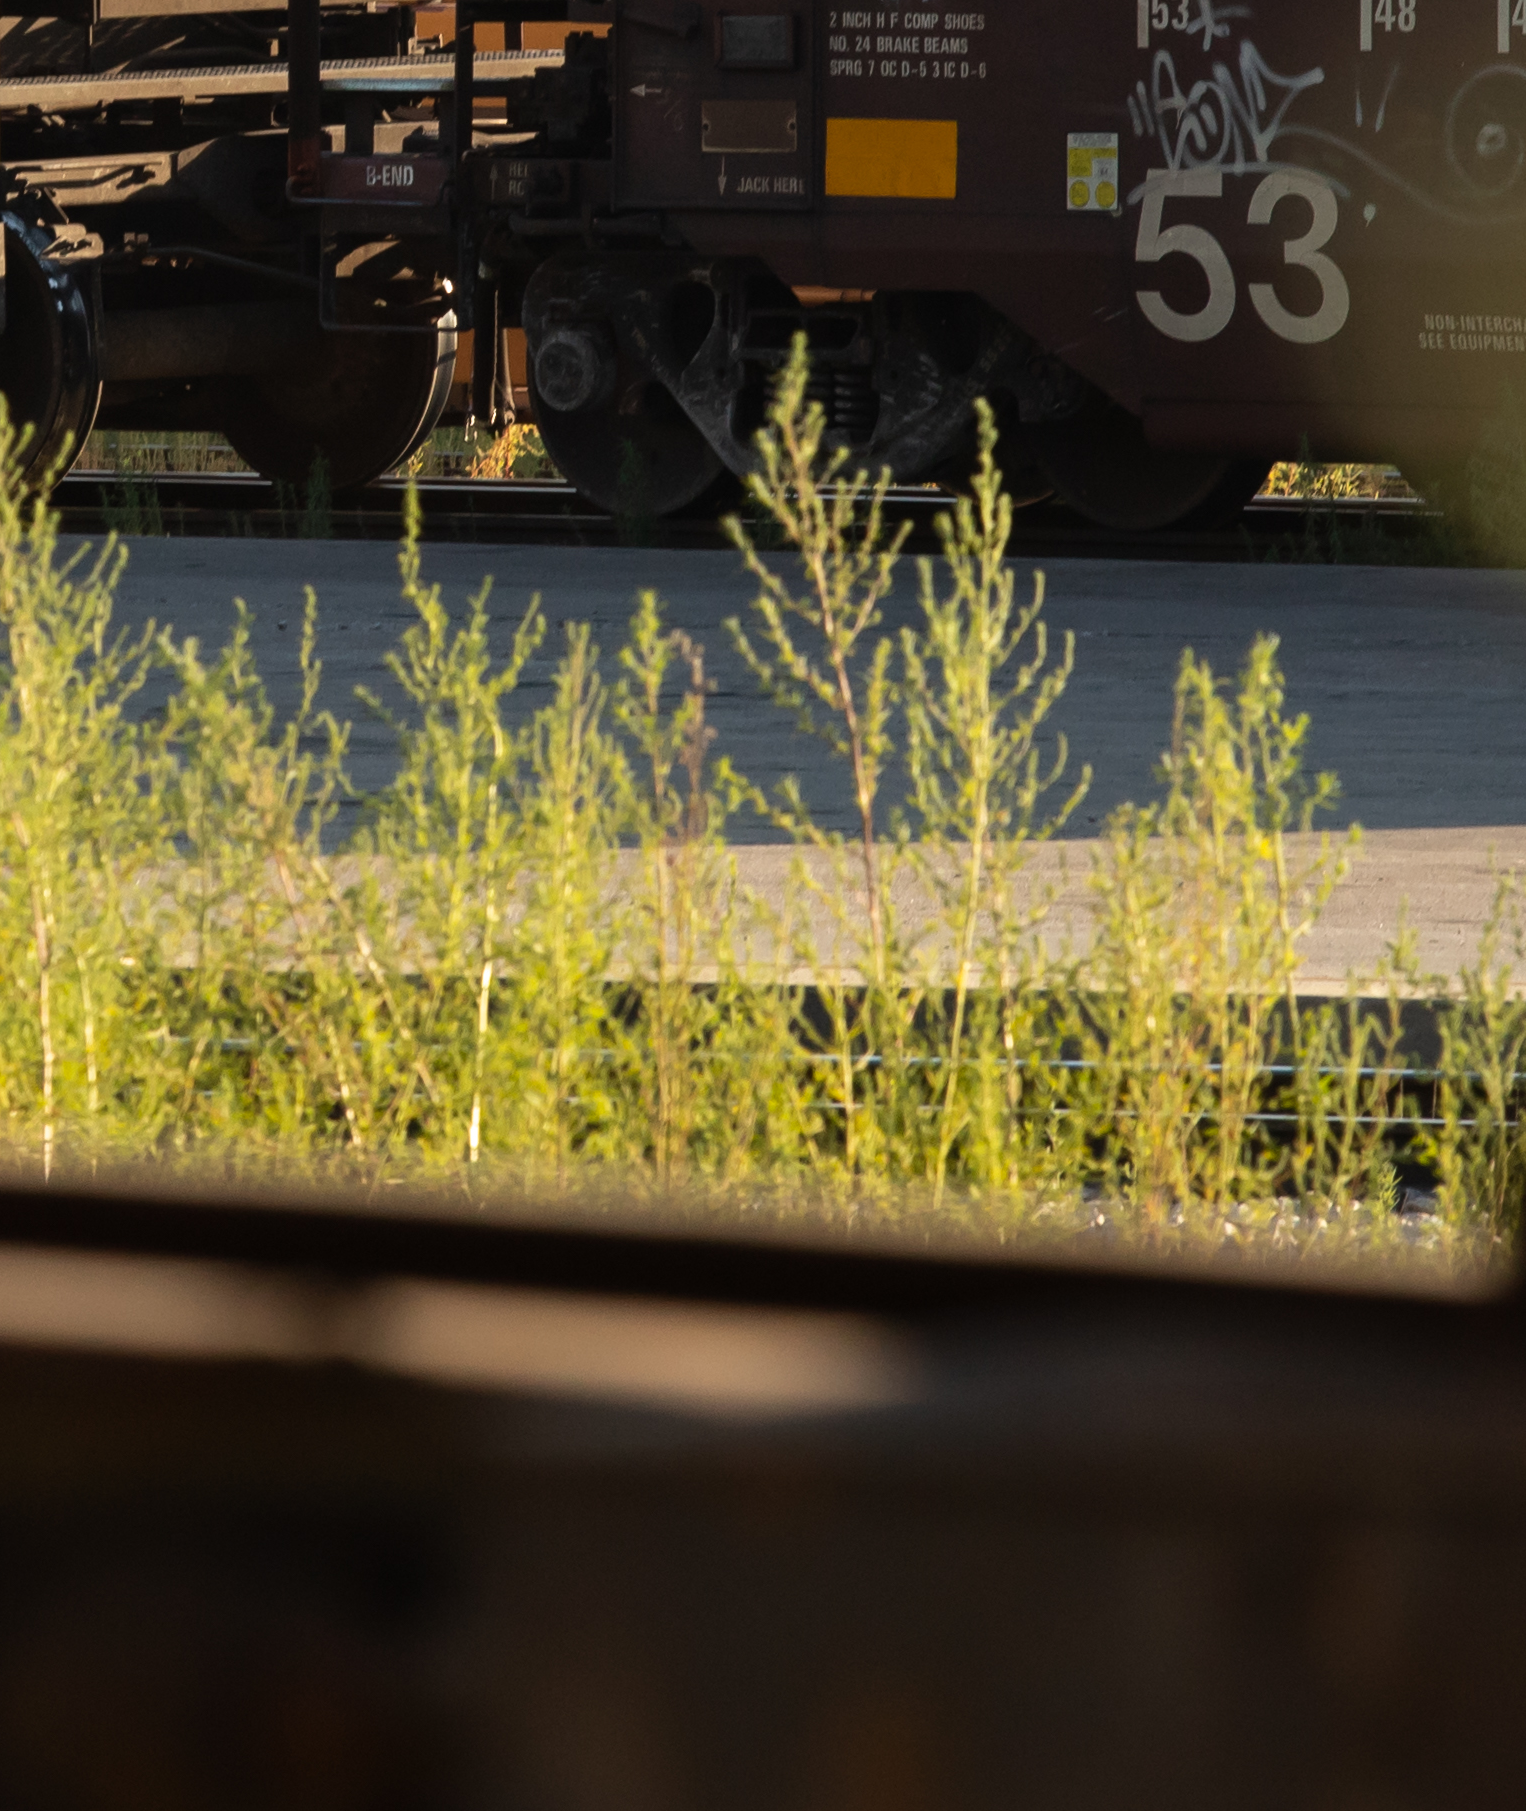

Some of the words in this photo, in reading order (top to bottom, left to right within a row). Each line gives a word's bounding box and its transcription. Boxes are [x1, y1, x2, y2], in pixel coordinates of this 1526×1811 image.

[829, 11, 837, 29] 2
[842, 11, 871, 30] INCH
[876, 12, 885, 29] H
[890, 12, 899, 29] F
[904, 12, 939, 30] COMP
[944, 13, 986, 31] SHOES
[829, 35, 850, 53] NO.
[855, 36, 870, 53] 24
[876, 36, 920, 54] BRAKE
[924, 37, 969, 55] BEAMS
[830, 59, 863, 77] SPRG
[868, 59, 875, 77] 7
[880, 60, 897, 77] OC
[932, 60, 940, 78] 3
[944, 60, 956, 78] IC
[366, 165, 414, 187] B-END
[736, 176, 771, 194] JACK
[773, 176, 806, 195] HERE
[1134, 169, 1349, 344] 53
[1419, 331, 1445, 350] SEE
